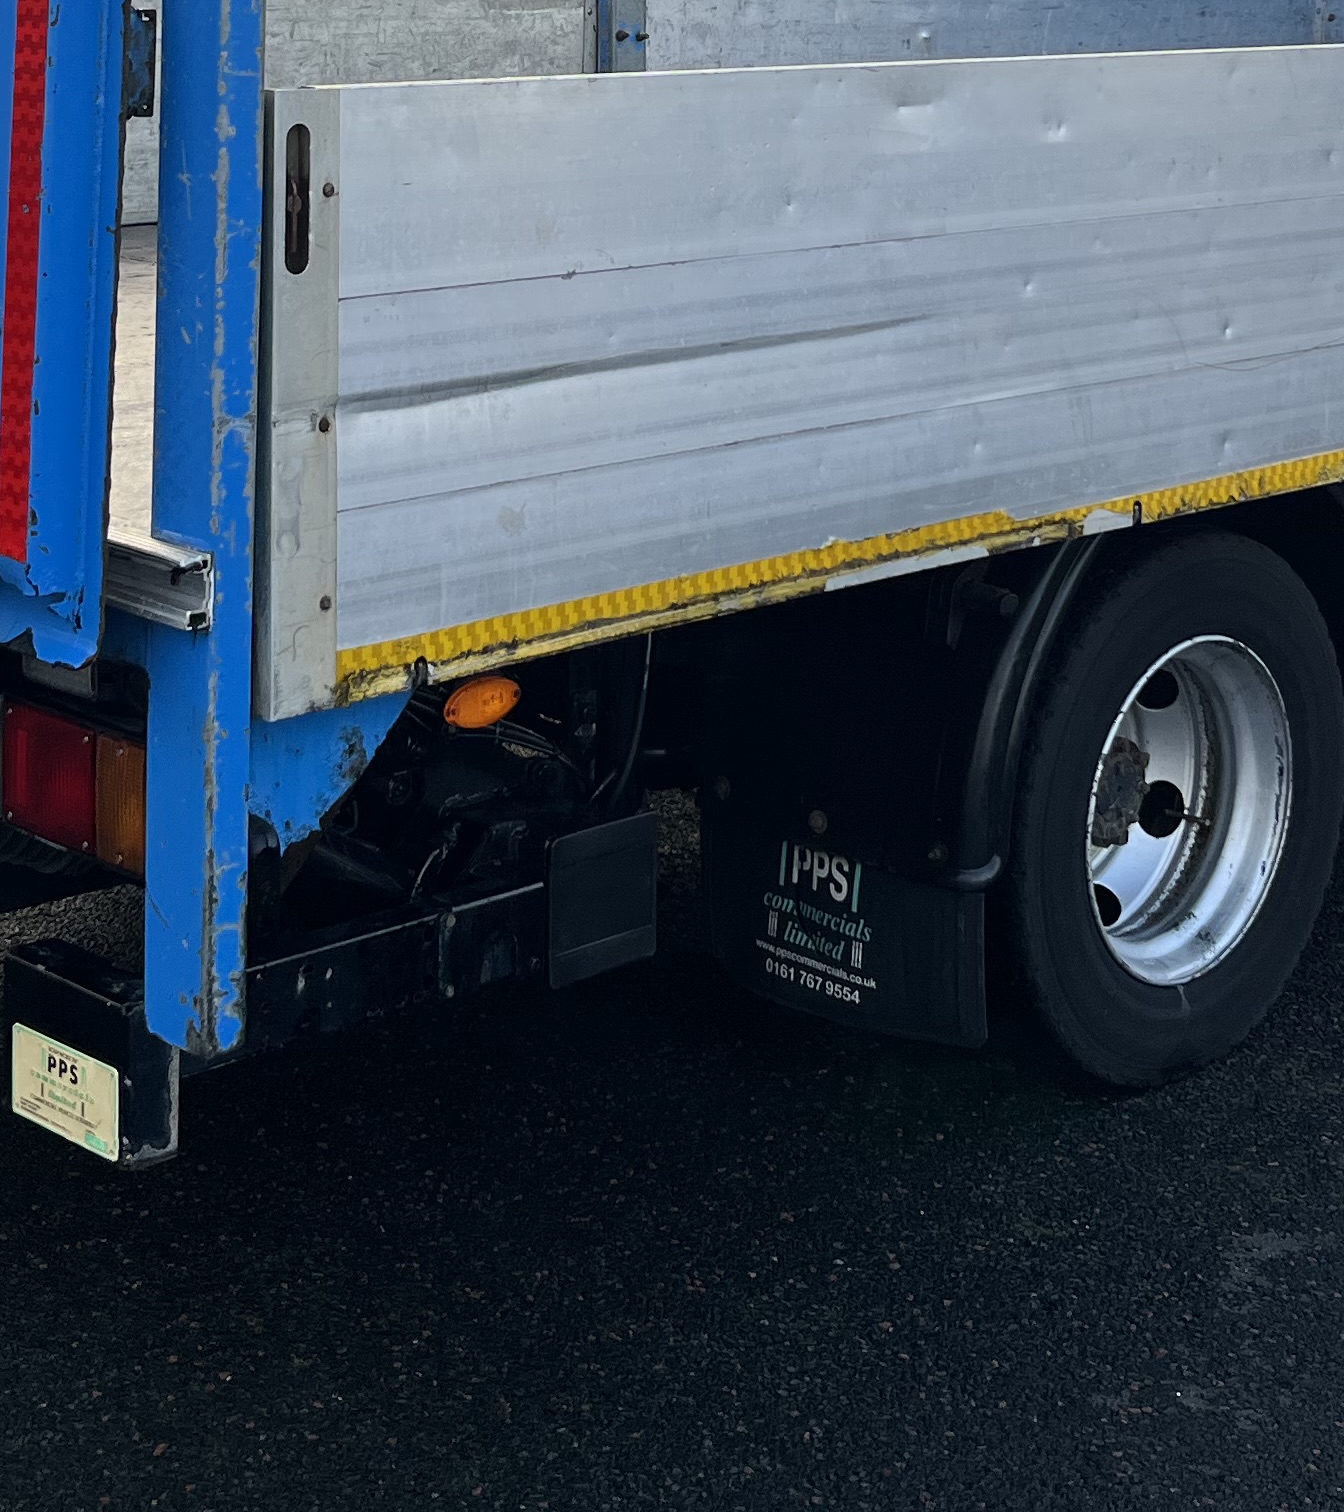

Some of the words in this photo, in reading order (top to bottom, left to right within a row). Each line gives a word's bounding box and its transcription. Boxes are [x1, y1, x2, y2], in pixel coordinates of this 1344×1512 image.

[792, 844, 849, 902] PPS
[763, 892, 873, 942] commercials
[784, 920, 845, 961] limited
[756, 938, 876, 989] www.ppscommercials.co.uk
[765, 957, 794, 982] 0161
[799, 969, 823, 991] 767
[825, 980, 861, 1004] 9554
[47, 1053, 78, 1085] PPS
